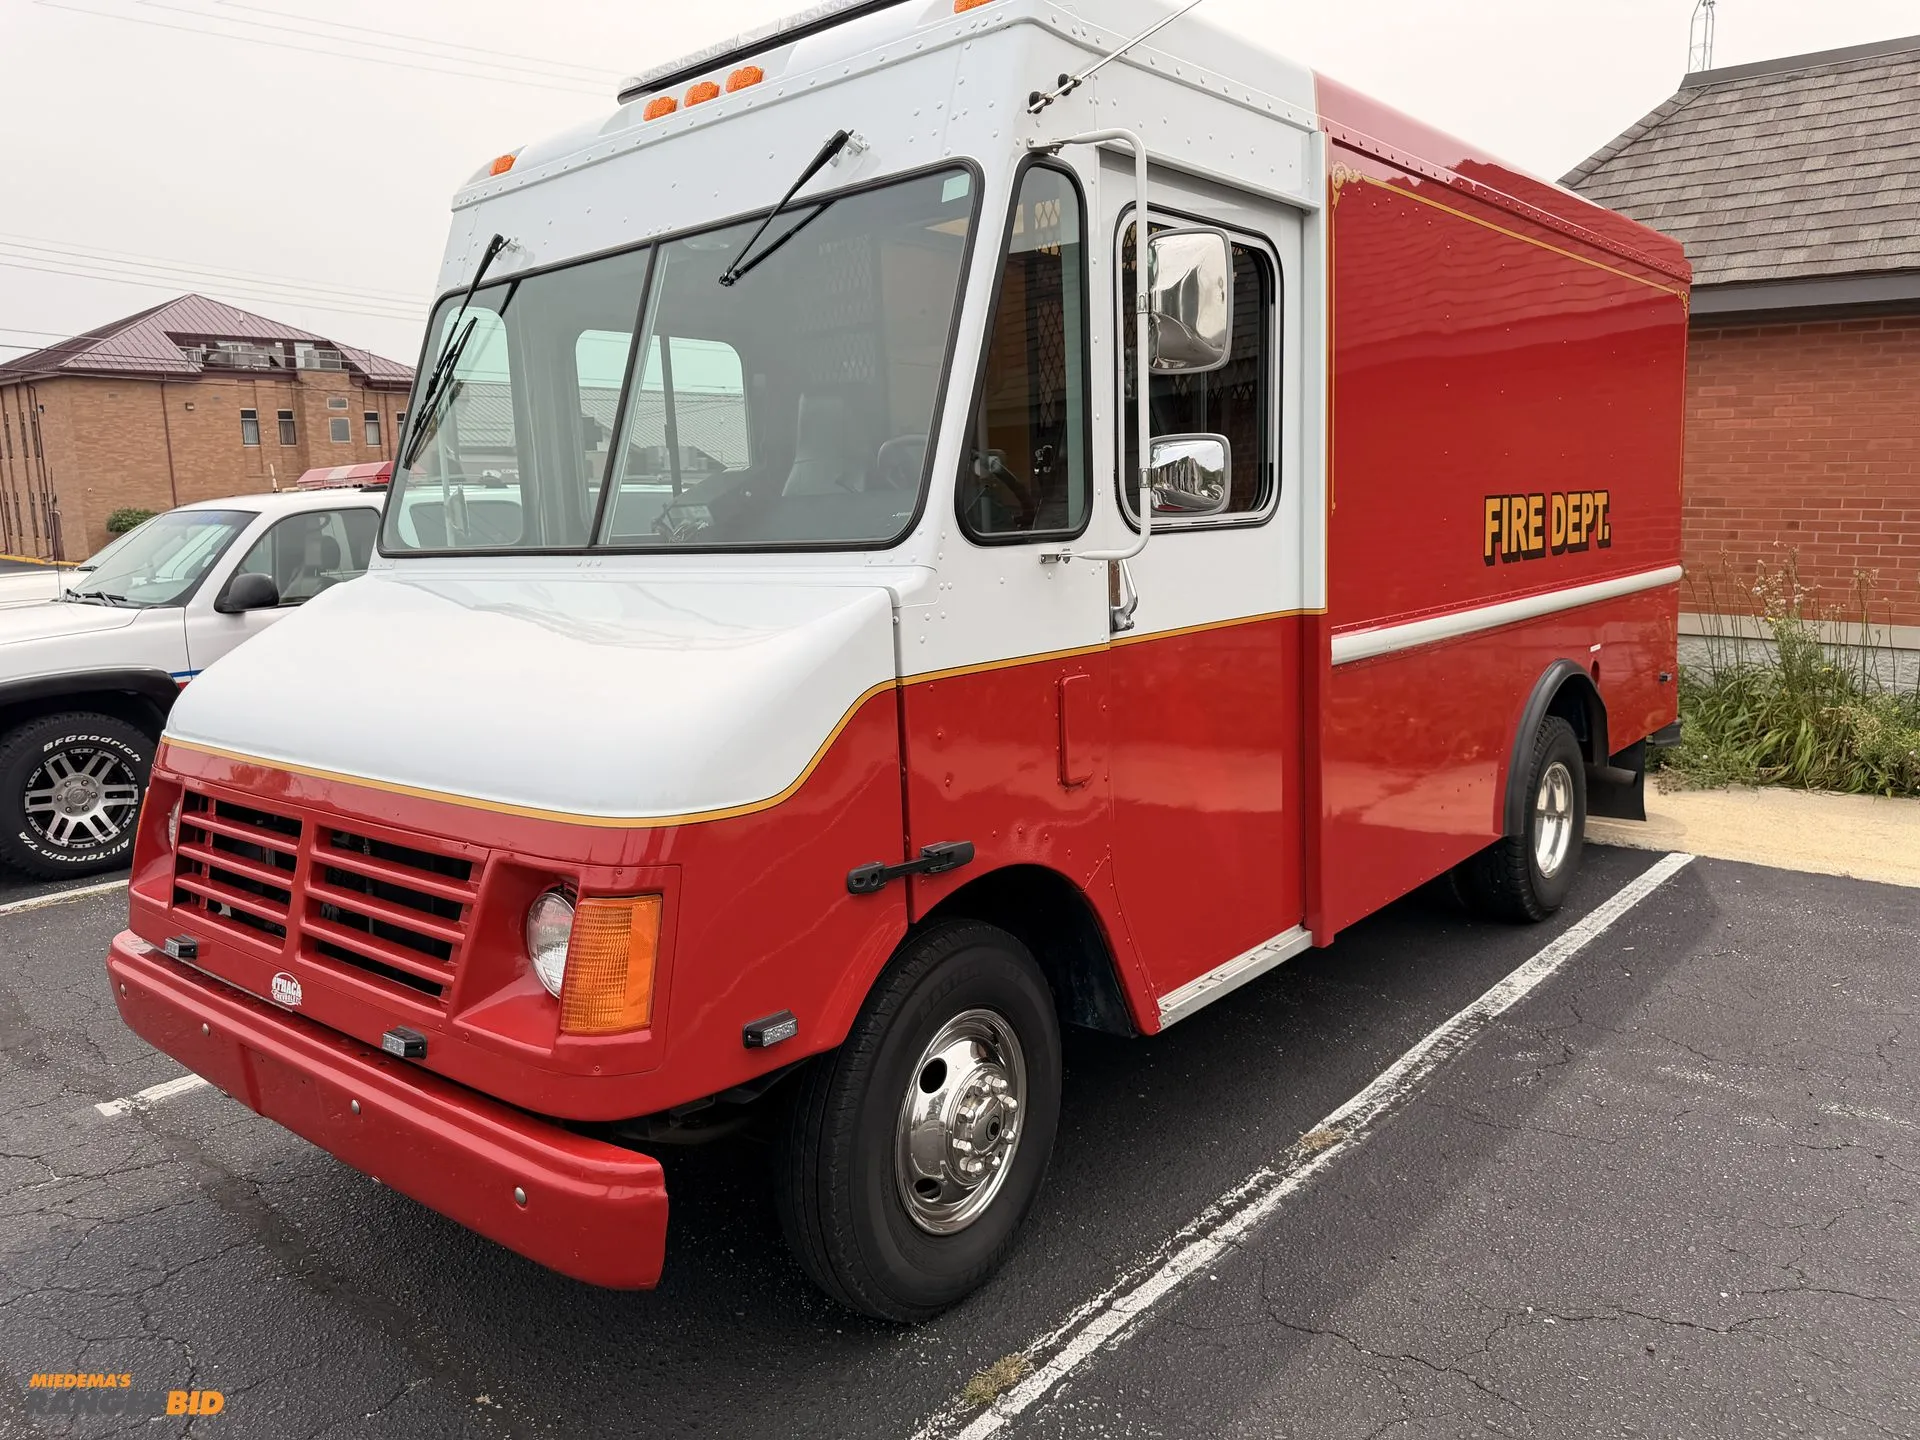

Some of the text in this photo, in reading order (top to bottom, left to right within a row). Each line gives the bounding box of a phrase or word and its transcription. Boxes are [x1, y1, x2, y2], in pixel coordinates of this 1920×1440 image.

[1484, 490, 1611, 566] FIRE DEPT.
[43, 734, 142, 762] BFGoodrich
